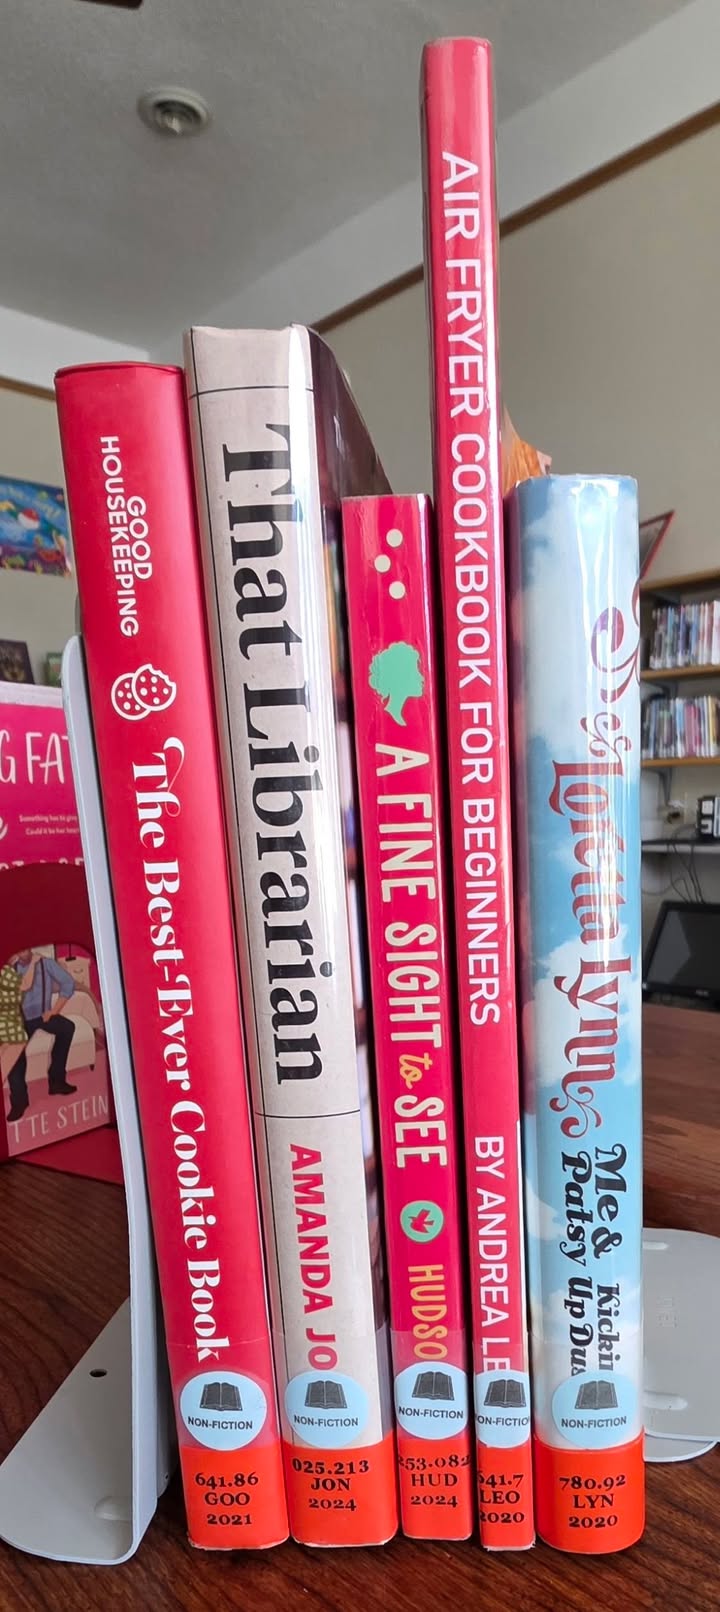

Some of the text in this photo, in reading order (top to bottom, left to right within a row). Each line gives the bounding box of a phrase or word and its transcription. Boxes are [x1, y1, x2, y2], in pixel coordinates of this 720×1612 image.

[100, 436, 139, 637] HOUSEKEEPING
[127, 495, 153, 580] GOOD
[442, 151, 500, 1026] AIR FRYER COOKBOOK FOR BEGINNERS
[26, 731, 69, 785] FA
[222, 423, 333, 1086] That Librarian
[549, 760, 631, 1084] Loretta Lynn
[375, 743, 448, 1168] A FINE SIGHT to SEE
[132, 736, 230, 1363] The Best-Ever Cookie Book
[474, 1136, 505, 1179] BY
[594, 1143, 627, 1222] Me
[559, 1151, 594, 1267] Patsy
[290, 1143, 338, 1370] AMANDA JO
[476, 1187, 511, 1327] ANDREA
[564, 1276, 594, 1319] Up
[407, 1264, 448, 1360] HUDSO
[293, 1415, 359, 1427] NON-FICTION
[399, 1406, 464, 1419] NON-FICTION
[475, 1414, 530, 1426] ON-FICTIO
[188, 1416, 253, 1430] NON-FICTION
[561, 1416, 627, 1428] NON-FICTION
[292, 1458, 370, 1475] 025.213
[195, 1472, 259, 1488] 641.86
[310, 1477, 351, 1491] JON
[411, 1473, 458, 1486] HUD
[559, 1474, 626, 1491] 780.92
[204, 1492, 251, 1506] GOO
[308, 1498, 357, 1511] 2024
[410, 1495, 458, 1508] 2024
[479, 1489, 520, 1504] LEO
[573, 1494, 614, 1508] LYN
[206, 1513, 252, 1525] 2021
[569, 1515, 618, 1528] 2020
